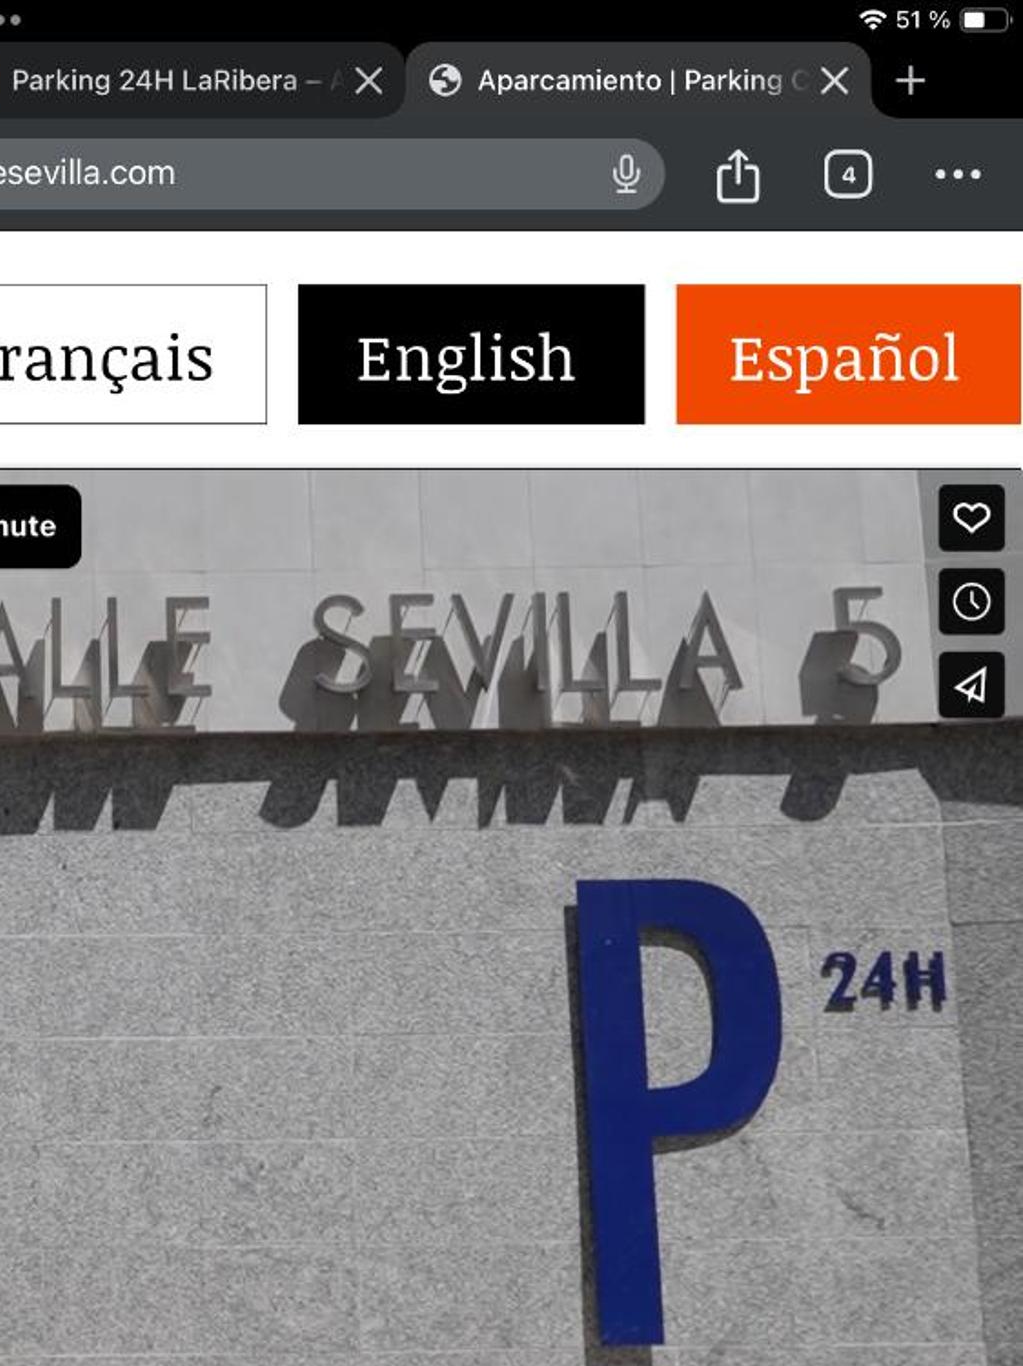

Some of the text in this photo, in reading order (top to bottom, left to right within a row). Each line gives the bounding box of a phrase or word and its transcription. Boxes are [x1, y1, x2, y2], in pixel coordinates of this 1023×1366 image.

[897, 10, 950, 29] 51 %
[13, 68, 113, 96] Parking
[119, 68, 173, 91] 24H
[183, 68, 297, 92] LaRibera
[478, 69, 662, 95] Aparcamiento
[684, 68, 782, 95] Parking
[842, 166, 856, 183] 4
[358, 331, 575, 394] English
[731, 331, 959, 394] Español
[313, 591, 743, 694] SEVILLA
[832, 587, 902, 687] 5
[820, 951, 947, 1009] 24H
[576, 880, 782, 1347] P
